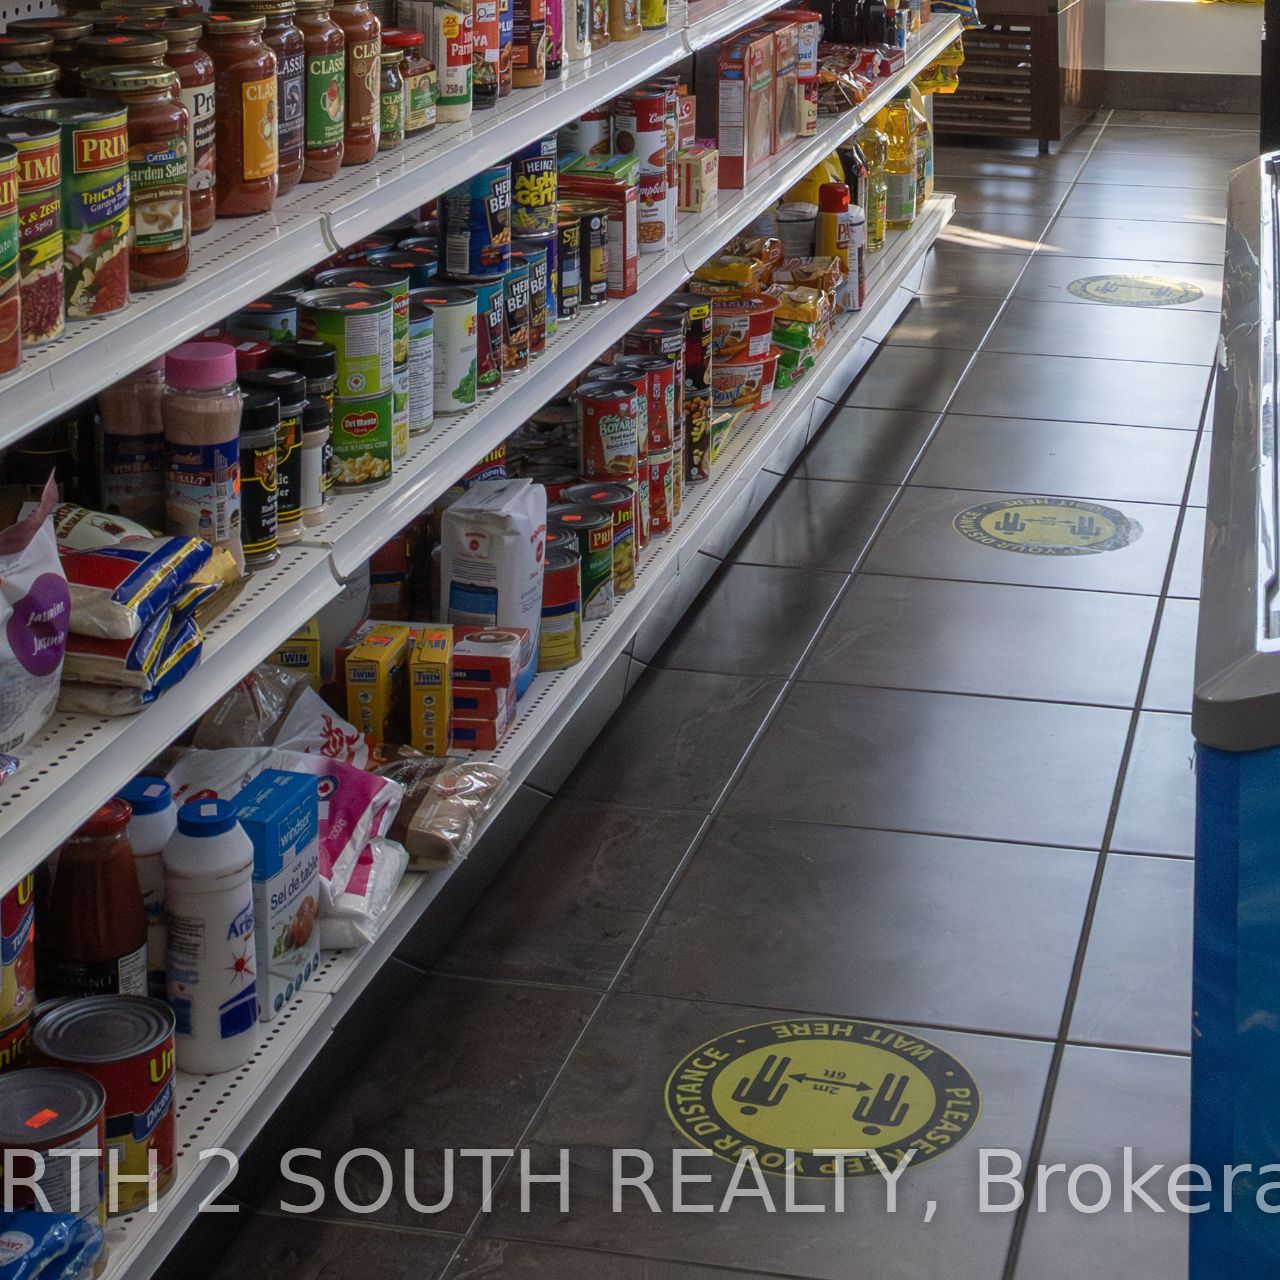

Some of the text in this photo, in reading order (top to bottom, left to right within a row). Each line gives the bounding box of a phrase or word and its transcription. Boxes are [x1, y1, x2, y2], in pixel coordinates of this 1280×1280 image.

[445, 16, 457, 25] 2X
[82, 129, 128, 163] PRIM
[526, 160, 553, 173] HEINZ
[81, 189, 114, 206] THICK
[600, 420, 637, 436] BOYARD
[27, 600, 65, 626] Jasmine
[350, 670, 377, 682] TWIN
[270, 888, 287, 911] Sel
[288, 881, 300, 898] de
[771, 1021, 934, 1062] WAIT HERE
[822, 1068, 847, 1081] 6ft
[676, 1046, 731, 1136] DISTANCE
[811, 1083, 841, 1095] 2m
